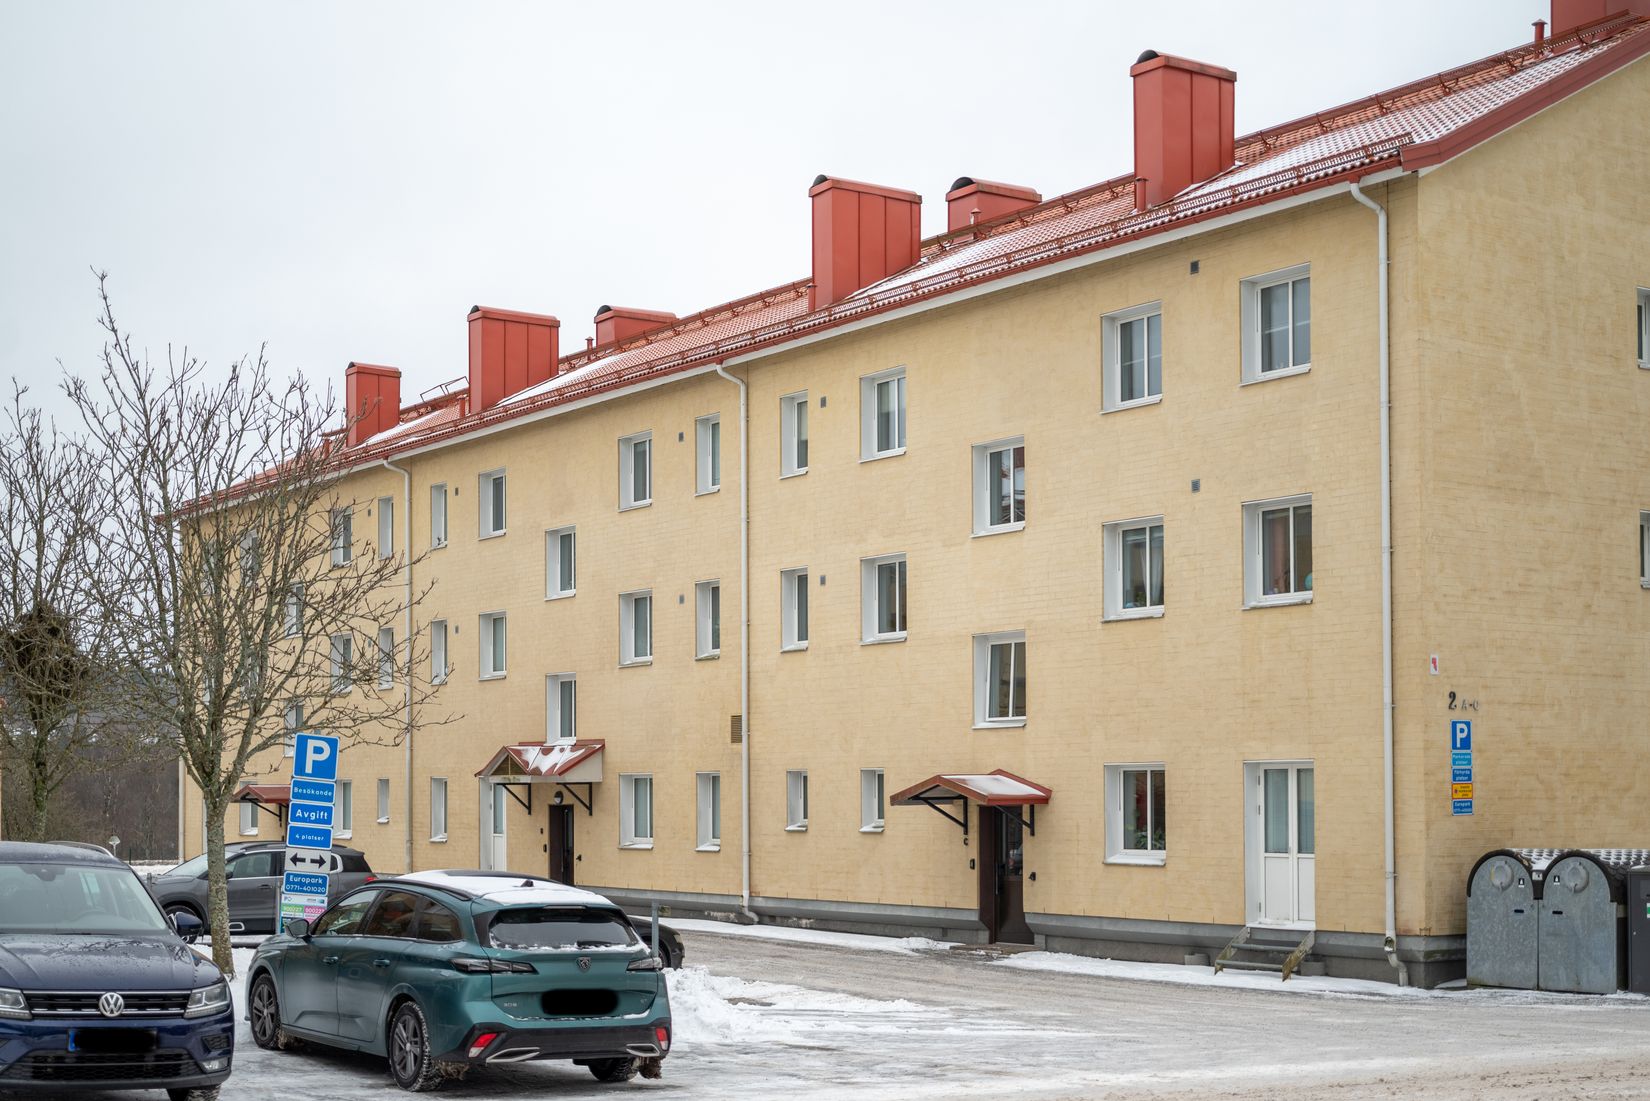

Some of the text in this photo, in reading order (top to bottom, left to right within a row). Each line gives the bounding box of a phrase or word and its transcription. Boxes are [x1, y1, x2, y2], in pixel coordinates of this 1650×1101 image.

[1449, 691, 1457, 711] 2
[1456, 723, 1468, 748] P
[305, 738, 331, 774] P
[293, 787, 333, 797] Besökande
[295, 809, 328, 820] Avgift
[289, 874, 323, 885] Europark
[285, 884, 326, 893] 0771-401020
[99, 992, 125, 1018] VW
